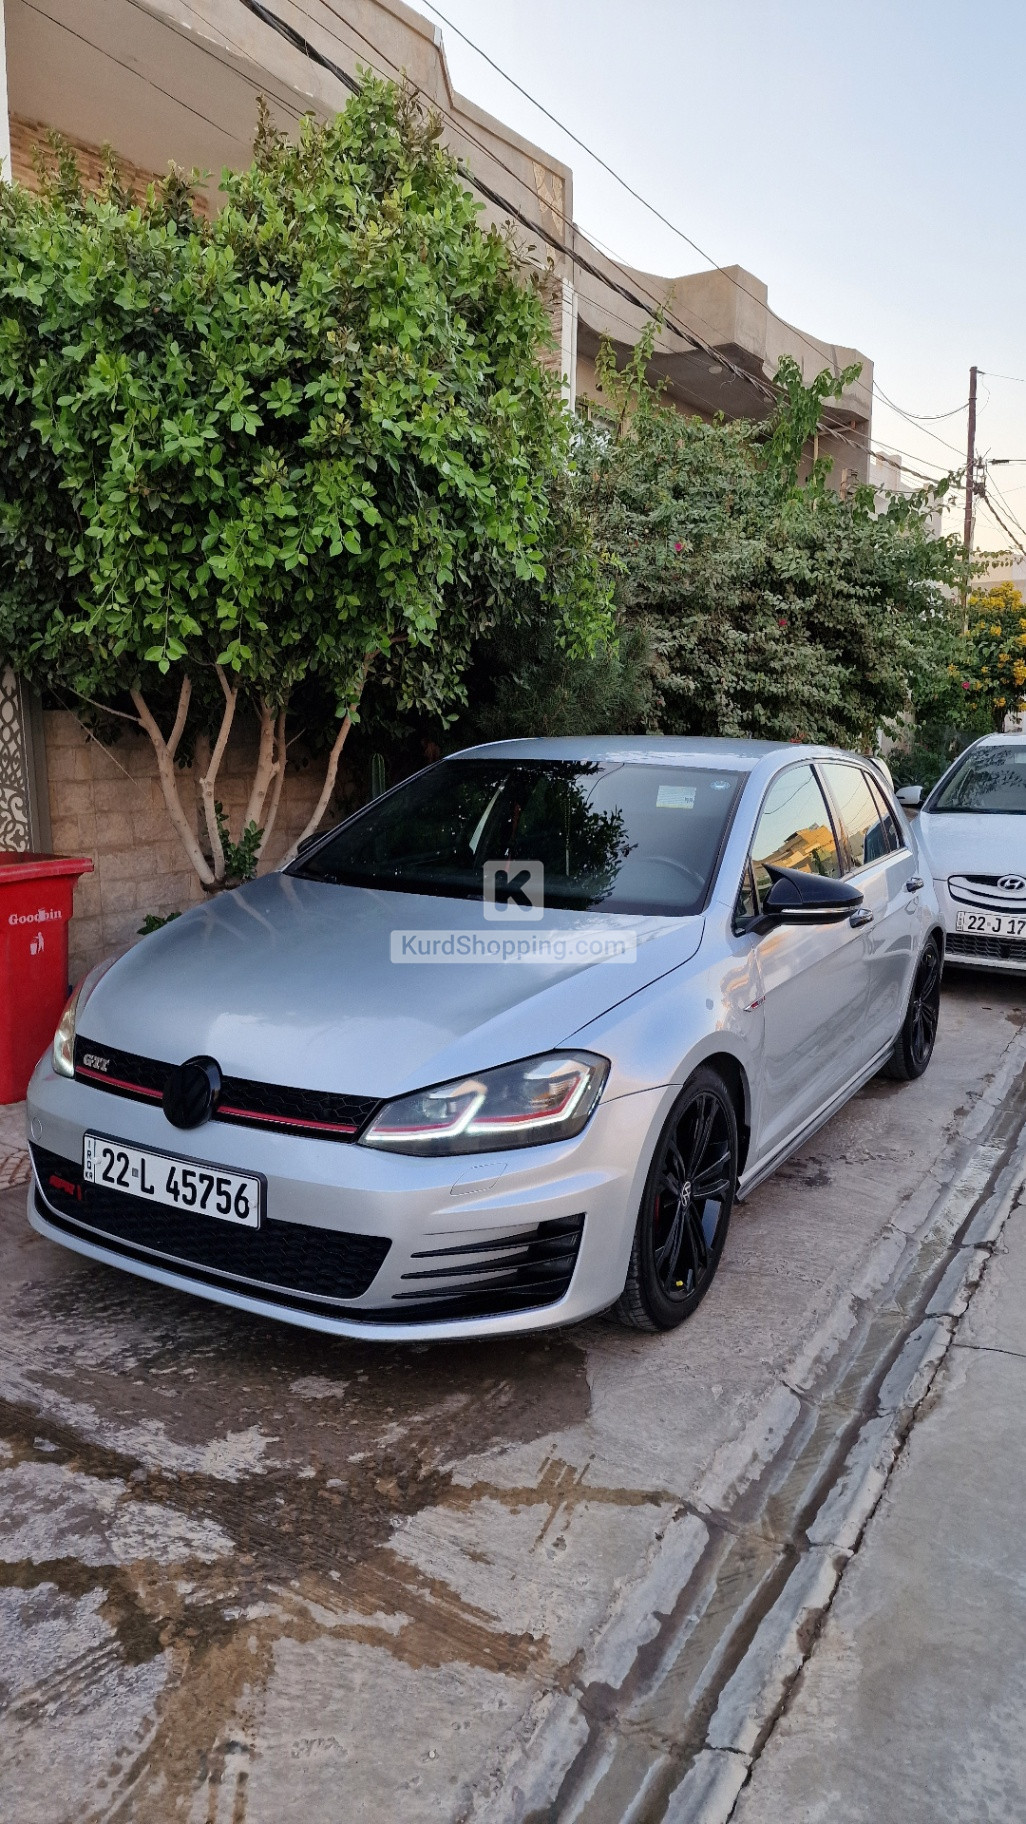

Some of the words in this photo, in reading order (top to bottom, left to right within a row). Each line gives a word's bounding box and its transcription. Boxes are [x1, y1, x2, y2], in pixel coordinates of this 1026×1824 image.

[968, 915, 986, 931] 22
[992, 917, 1002, 932] J
[1007, 919, 1026, 935] 17
[83, 1055, 109, 1071] GTI
[102, 1148, 130, 1187] 22
[141, 1158, 154, 1194] L
[166, 1166, 250, 1219] 45756
